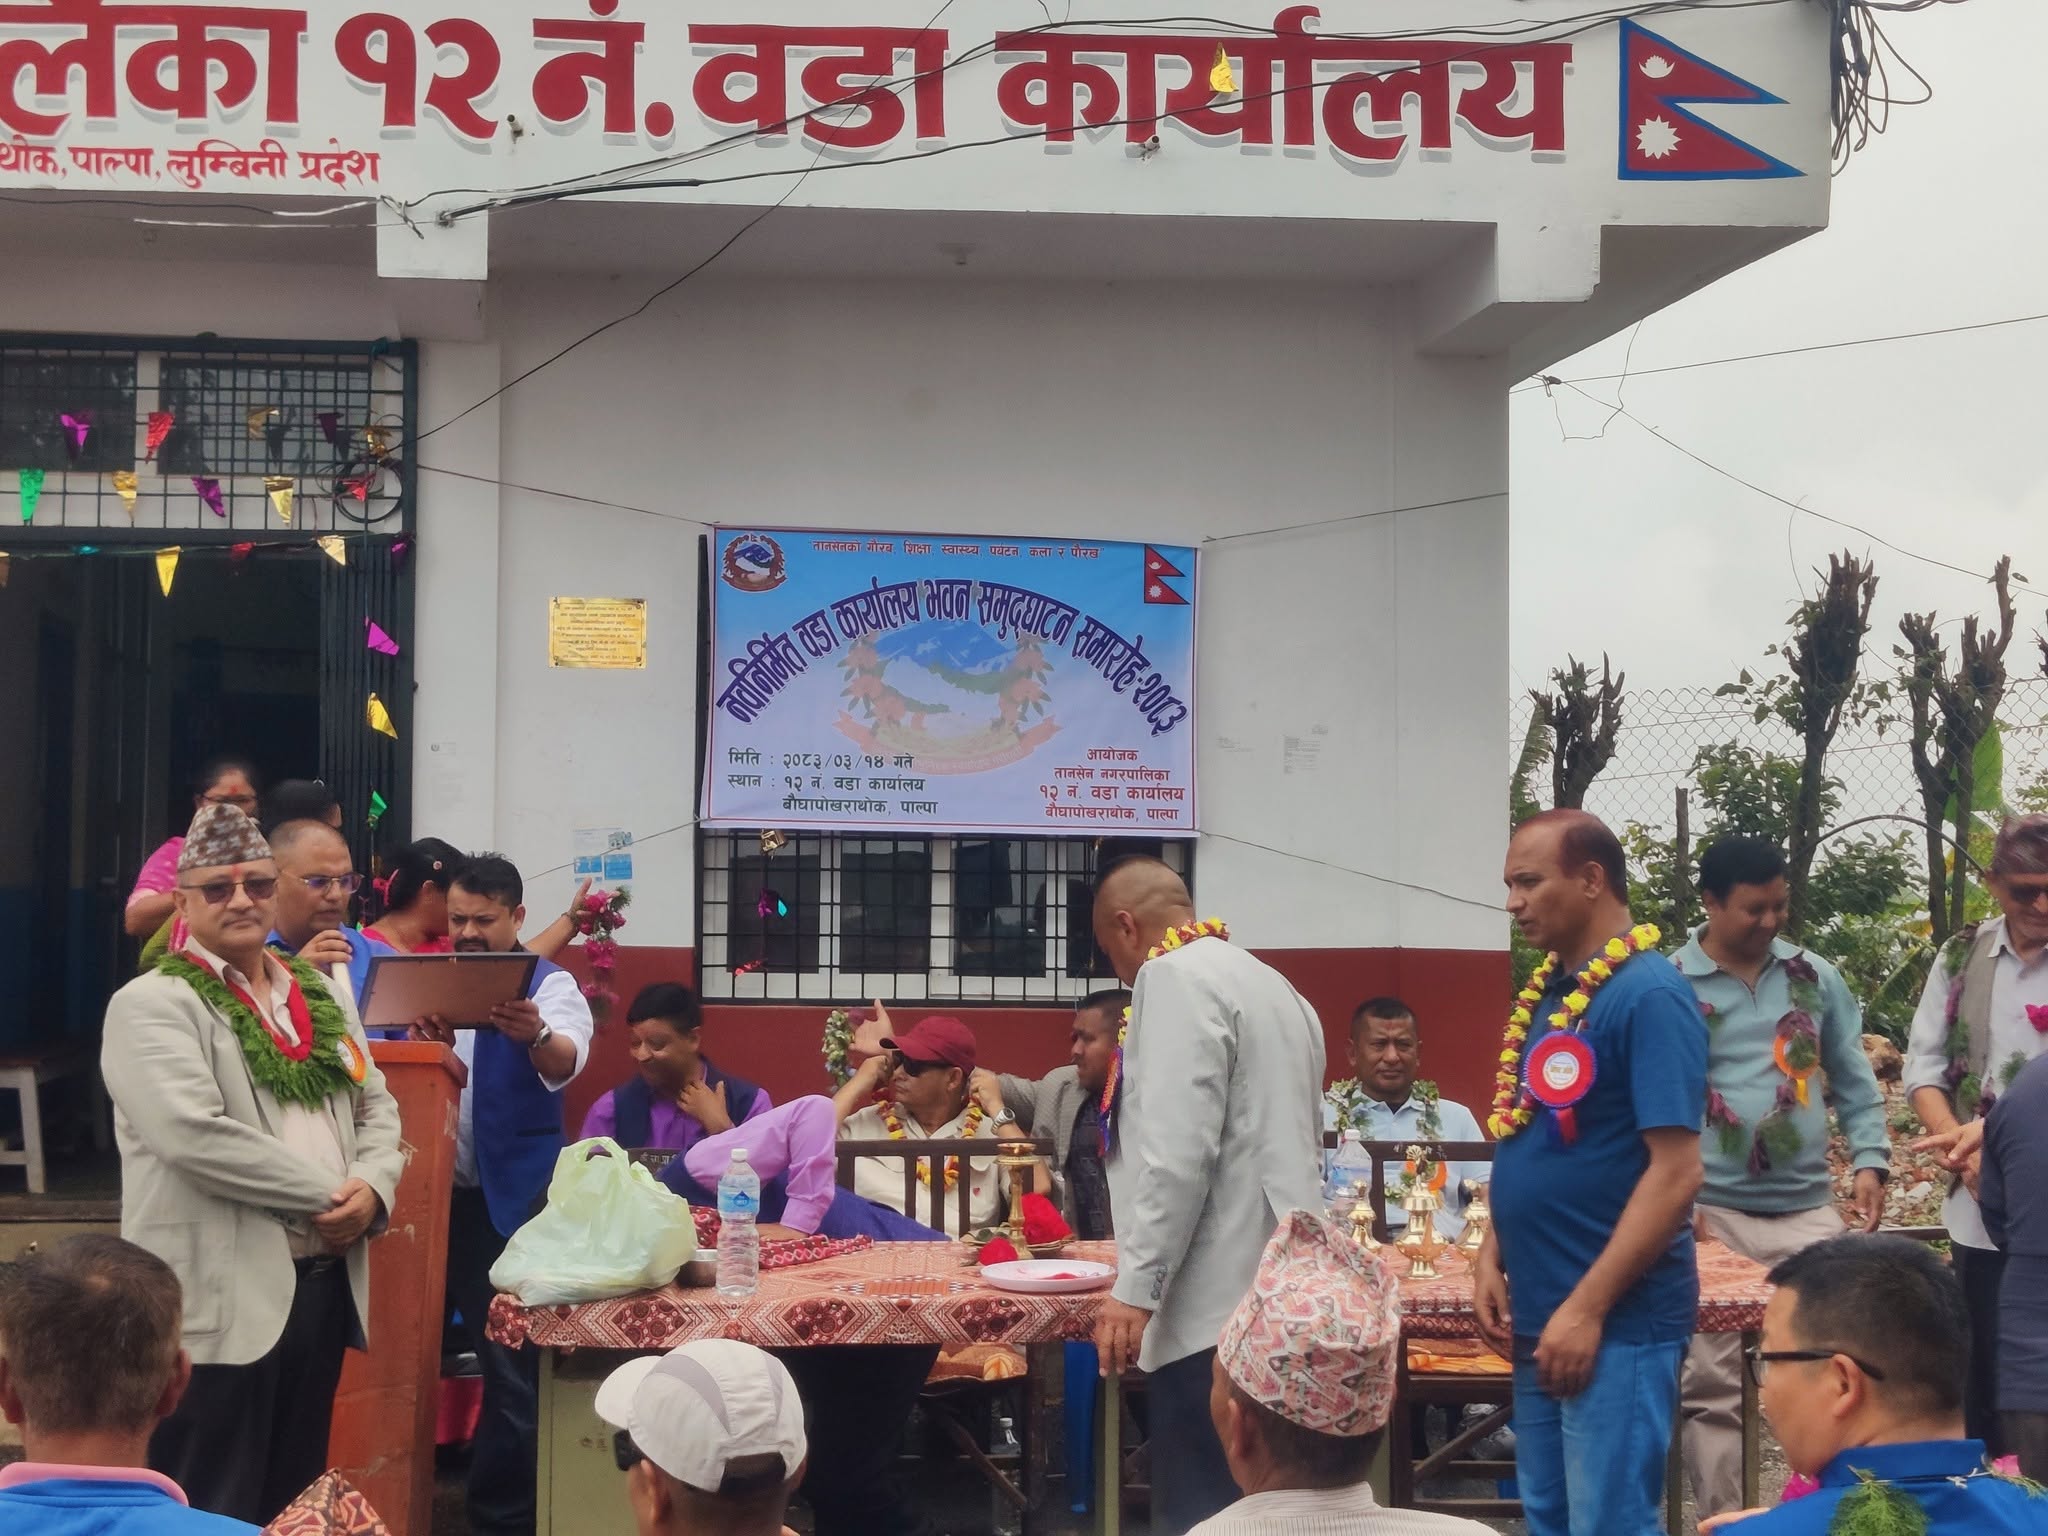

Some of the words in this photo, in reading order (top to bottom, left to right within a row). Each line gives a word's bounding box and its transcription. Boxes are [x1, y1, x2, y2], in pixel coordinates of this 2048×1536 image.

[335, 13, 501, 139] १२
[688, 24, 949, 147] वडा
[995, 6, 1573, 160] कार्यालय
[68, 146, 161, 182] पाल्पा,
[166, 138, 288, 189] लुम्बिनी
[297, 137, 381, 191] प्रदेश
[716, 632, 808, 724] नवनिर्मित
[792, 609, 840, 658] वडा
[830, 576, 921, 639] कार्यालय
[924, 578, 973, 621] भवन
[728, 747, 761, 766] मिति
[783, 753, 884, 770] २०८३/०३/१४
[893, 753, 914, 769] गते
[1087, 746, 1139, 761] आयोजक
[1054, 765, 1095, 780] तानसेन
[1100, 766, 1170, 782] नगरपालिका
[728, 774, 763, 788] स्थान
[784, 776, 802, 792] १२
[834, 777, 861, 791] वडा
[868, 774, 926, 792] कार्यालय
[1040, 784, 1058, 801] १२
[1090, 786, 1119, 800] वडा
[1126, 783, 1185, 802] कार्यालय
[900, 801, 938, 815] पाल्पा
[1147, 808, 1179, 820] पाल्पा
